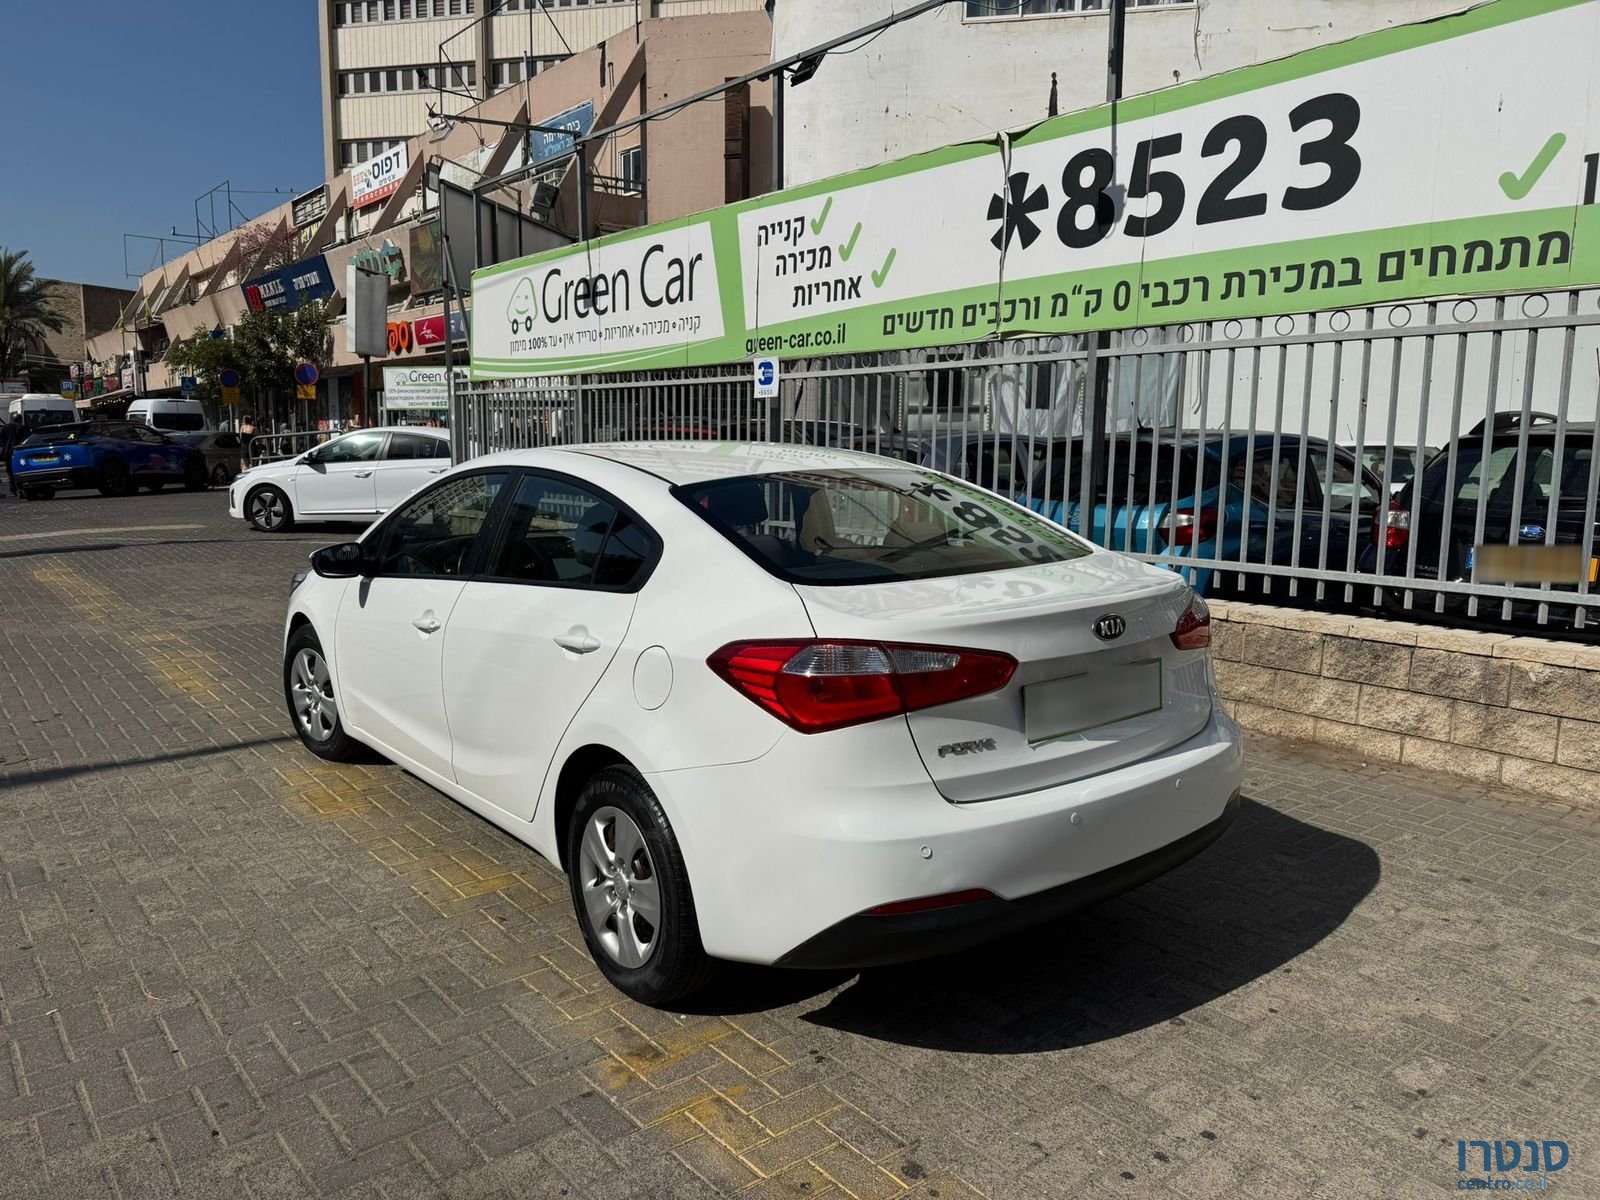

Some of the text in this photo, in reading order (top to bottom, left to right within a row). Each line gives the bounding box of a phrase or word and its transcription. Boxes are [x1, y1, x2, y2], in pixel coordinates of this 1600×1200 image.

[372, 151, 400, 179] דפוס
[757, 215, 806, 247] קנייה
[775, 245, 832, 277] מכירה
[1377, 230, 1572, 283] מתמחים
[542, 244, 703, 324] Green Car
[792, 275, 863, 308] אחריות
[1141, 275, 1209, 308] רכבי
[1220, 256, 1363, 300] במכירת
[961, 296, 1041, 328] ורכבים
[1113, 280, 1131, 312] 0
[510, 315, 701, 356] קניה מכירה אחריות טרייד אין עד 100% מימון
[882, 307, 955, 336] חדשים
[745, 322, 846, 355] green-car.co.il
[409, 370, 442, 383] Green
[1100, 618, 1124, 637] KIA
